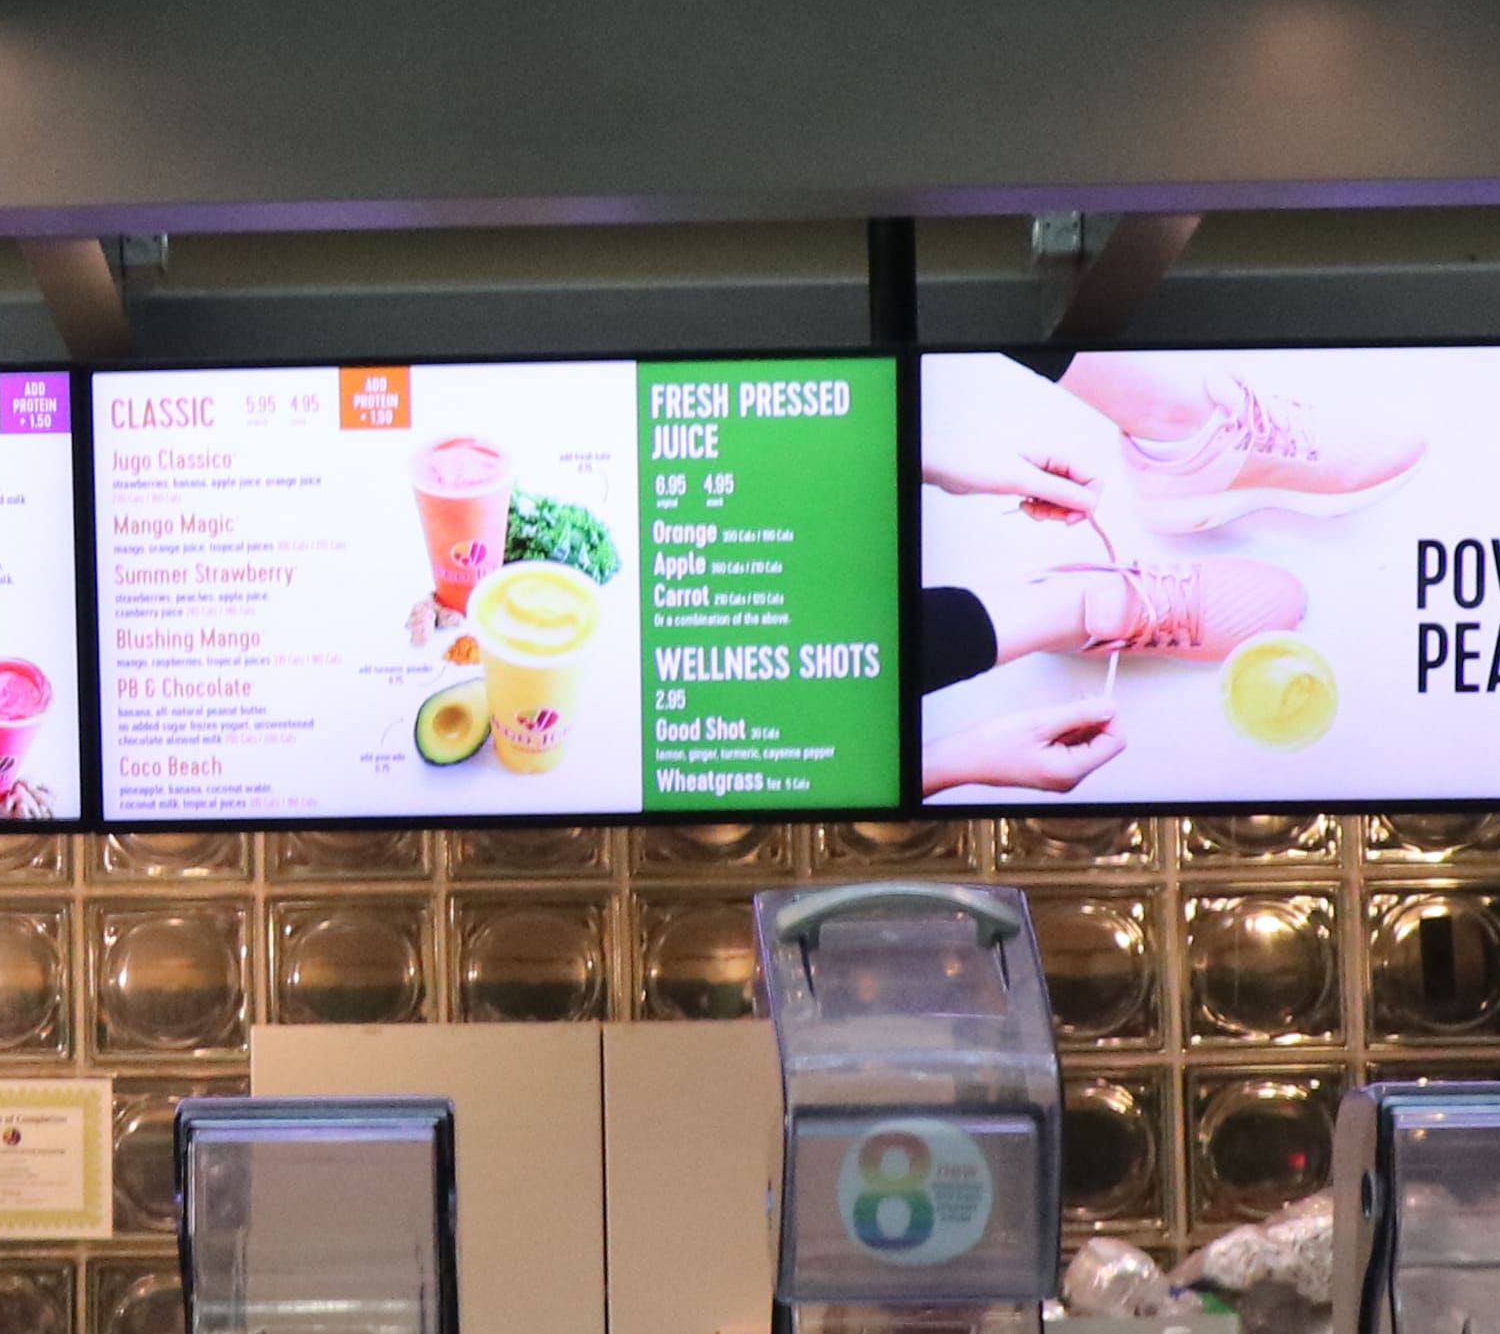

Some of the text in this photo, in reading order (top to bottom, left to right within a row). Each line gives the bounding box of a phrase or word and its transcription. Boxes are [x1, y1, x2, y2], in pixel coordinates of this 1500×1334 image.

[24, 381, 45, 396] ADD
[651, 380, 850, 419] FRESH PRESSED
[13, 398, 56, 413] PROTEIN
[111, 395, 319, 429] CLASSIC 5.95 4.95
[651, 423, 719, 460] JUICE
[112, 449, 232, 475] Jugo Classico
[655, 473, 734, 496] 6.95 4.95
[114, 514, 234, 539] Mango Magic
[652, 520, 717, 548] Orange
[114, 563, 294, 587] Summer Strawberry
[654, 551, 706, 580] Apple
[654, 583, 709, 608] Carrot
[116, 629, 260, 652] Blushing Mango
[655, 643, 880, 682] WELLNESS SHOTS
[118, 677, 251, 699] PB Chocolate
[655, 690, 686, 711] 2.95
[655, 717, 746, 742] Good Shot
[120, 756, 222, 777] Coco Beach
[656, 768, 763, 796] Wheatgrass
[853, 1132, 934, 1251] 8
